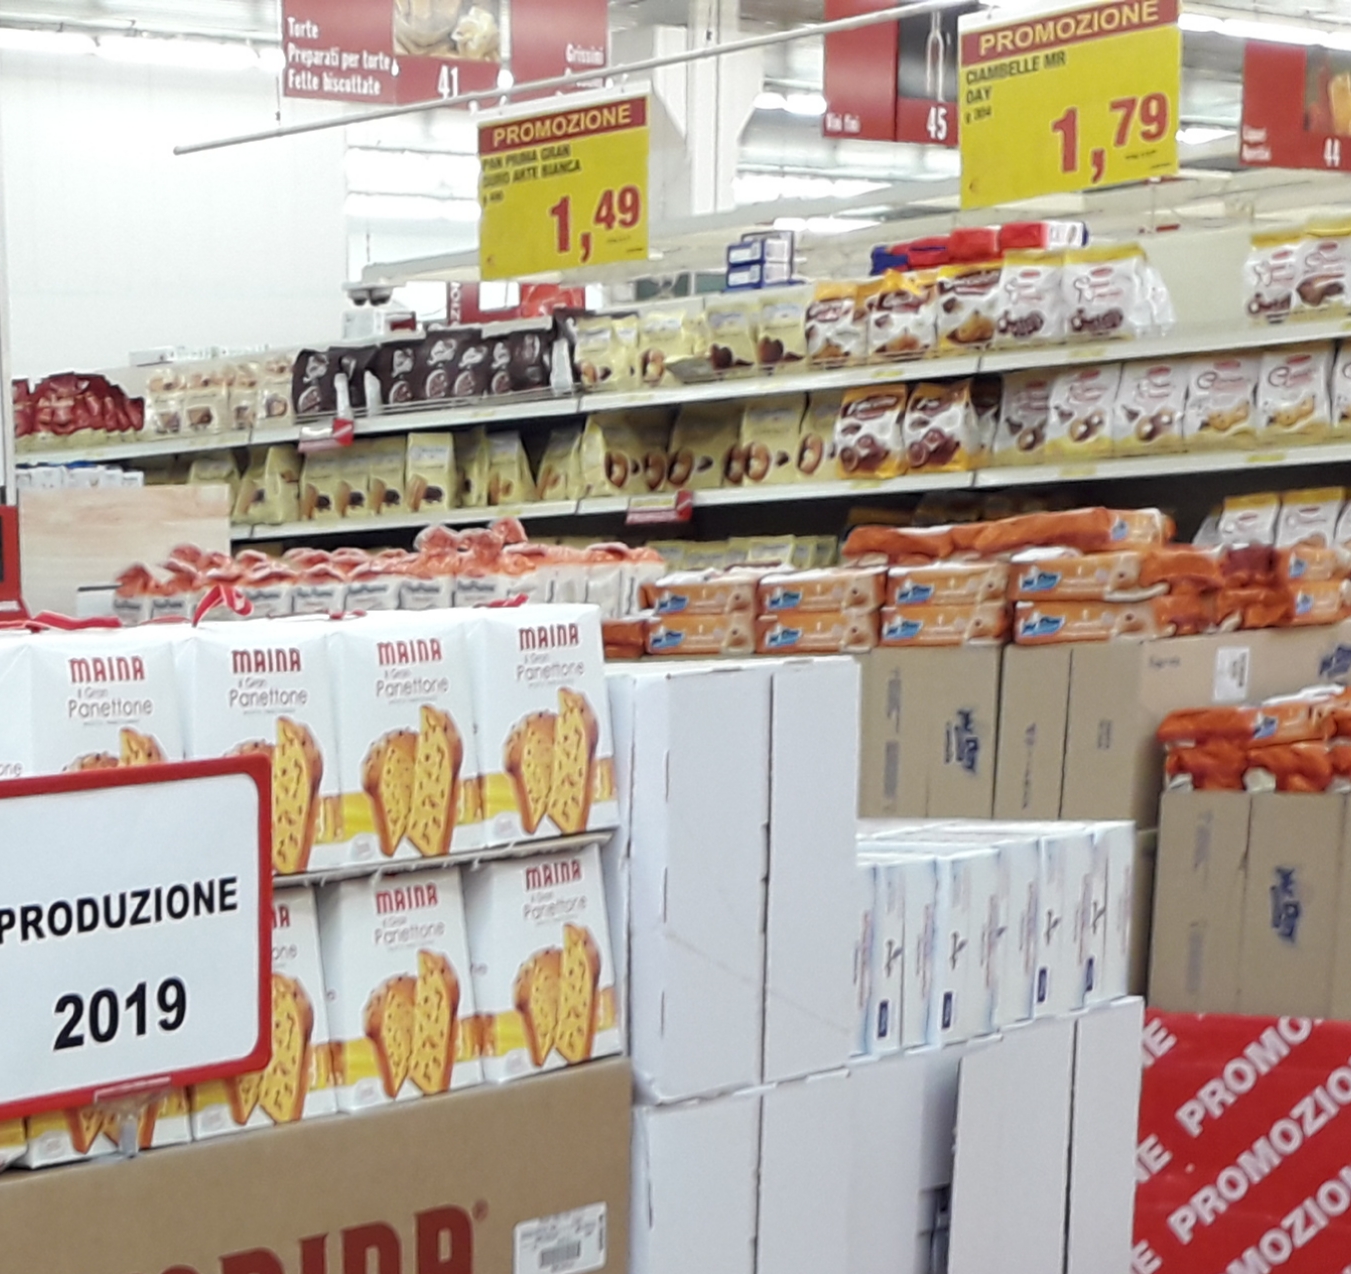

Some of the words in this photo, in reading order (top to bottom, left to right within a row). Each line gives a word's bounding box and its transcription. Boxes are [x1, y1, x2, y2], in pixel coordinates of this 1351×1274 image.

[286, 17, 320, 39] Torte
[979, 1, 1159, 57] PROMOZIONE
[286, 42, 339, 68] Preparati
[341, 49, 360, 71] per
[362, 50, 391, 72] torte
[966, 56, 1040, 85] CIAMBELLE
[1043, 50, 1066, 68] MR
[287, 68, 319, 92] Fette
[322, 72, 382, 95] biscottate
[437, 65, 460, 98] 41
[966, 86, 992, 104] DAY
[493, 104, 631, 148] PROMOZIONE
[926, 106, 948, 141] 45
[1051, 91, 1170, 184] 1,79
[512, 166, 539, 183] ARTE
[541, 159, 582, 179] BIANCA
[548, 184, 641, 263] 1,49
[518, 623, 580, 651] MAINA
[232, 648, 302, 674] MAINA
[376, 638, 442, 666] MAINA
[69, 656, 145, 683] MAINA
[516, 661, 585, 682] Panettone
[229, 688, 308, 708] Panettone
[375, 675, 449, 697] Panettone
[68, 699, 153, 718] Panettone
[526, 858, 581, 890] MAINA
[376, 883, 439, 914] MAINA
[374, 921, 445, 945] Panettone
[53, 976, 187, 1052] 2019
